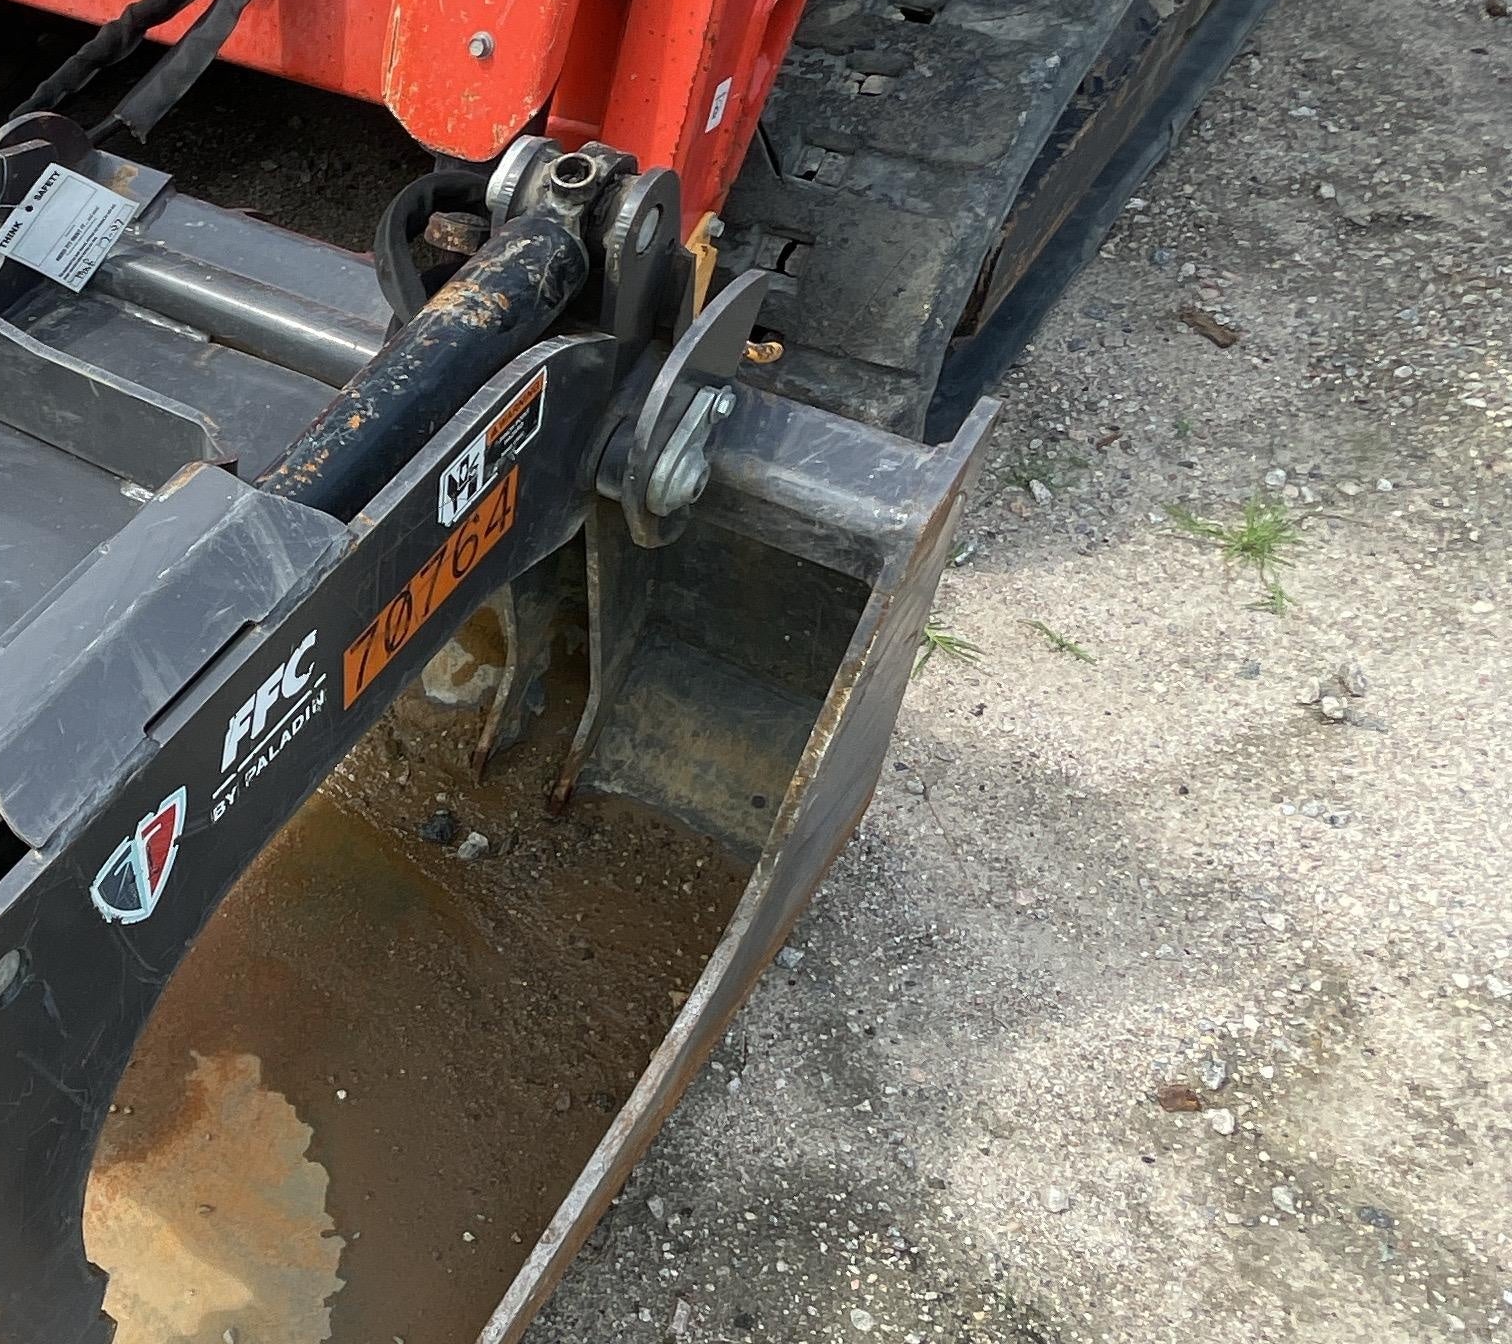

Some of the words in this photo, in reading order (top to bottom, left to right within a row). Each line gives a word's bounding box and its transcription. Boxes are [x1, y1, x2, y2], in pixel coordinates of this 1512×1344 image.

[33, 170, 62, 202] SAFETY
[350, 475, 513, 692] 70764
[211, 785, 238, 823] BY
[244, 688, 327, 788] PALADIN
[220, 628, 318, 774] FFC
